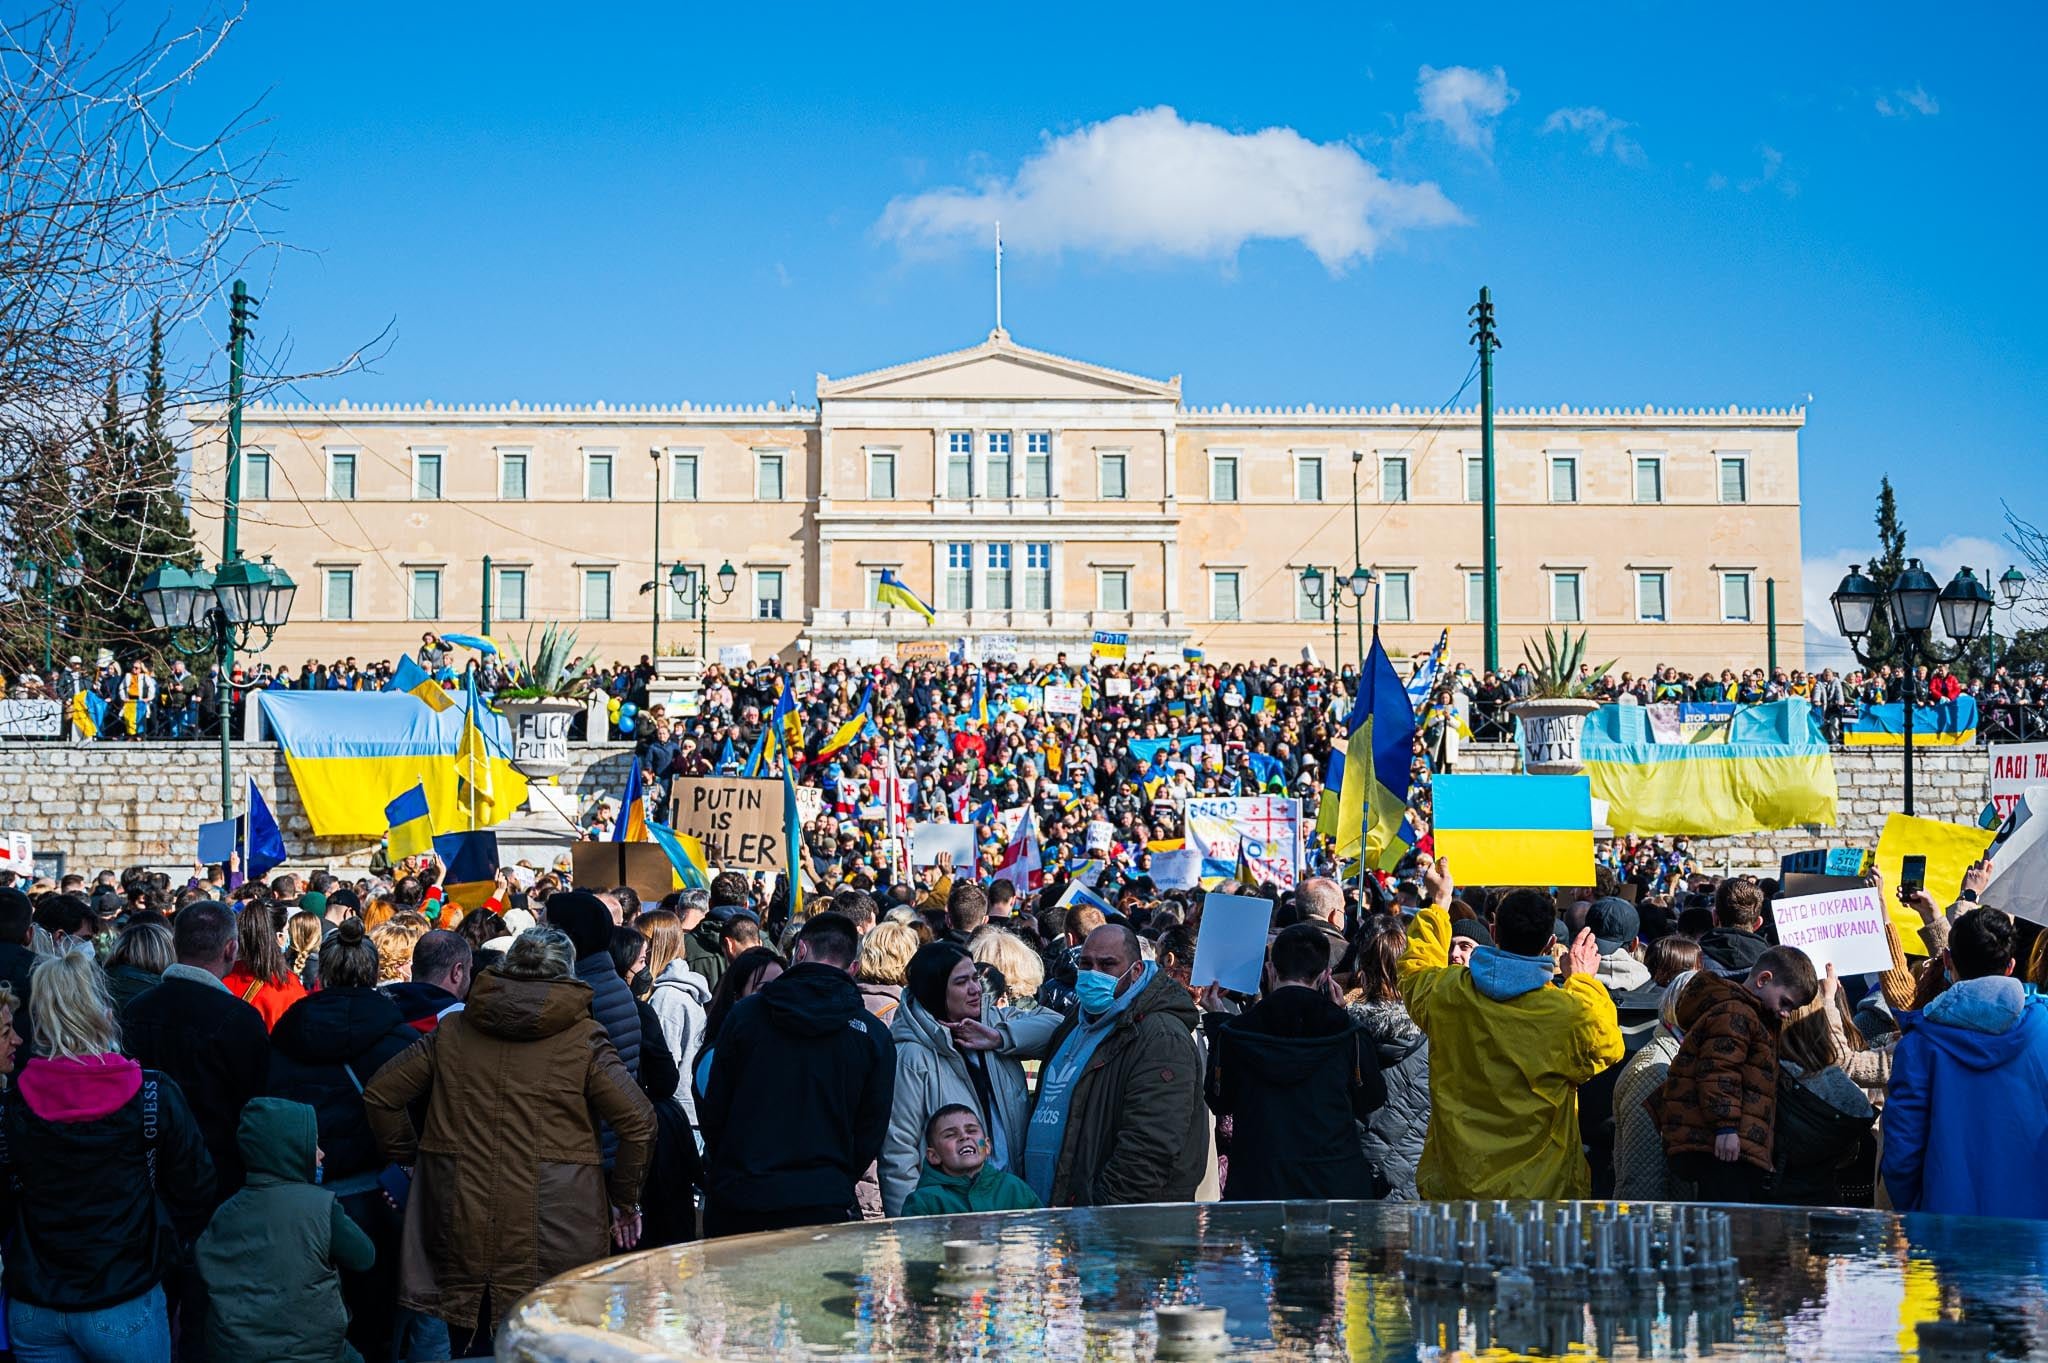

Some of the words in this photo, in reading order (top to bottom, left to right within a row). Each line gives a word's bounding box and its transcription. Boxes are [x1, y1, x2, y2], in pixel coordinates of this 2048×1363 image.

[520, 714, 571, 739] FUCK
[1526, 717, 1574, 744] UKRAINE
[1685, 714, 1707, 722] STOP
[518, 742, 565, 759] PUTIN
[1527, 743, 1573, 761] WIN
[1995, 755, 2027, 779] ΛΑΟΙ
[2035, 754, 2048, 778] ΤΗ
[694, 786, 761, 812] PUTIN
[711, 812, 732, 830] IS
[1777, 905, 1809, 924] ΖΗΤΩ
[1819, 895, 1874, 916] ΟΚΡΑΝΙΑ
[143, 1081, 158, 1139] GUESS
